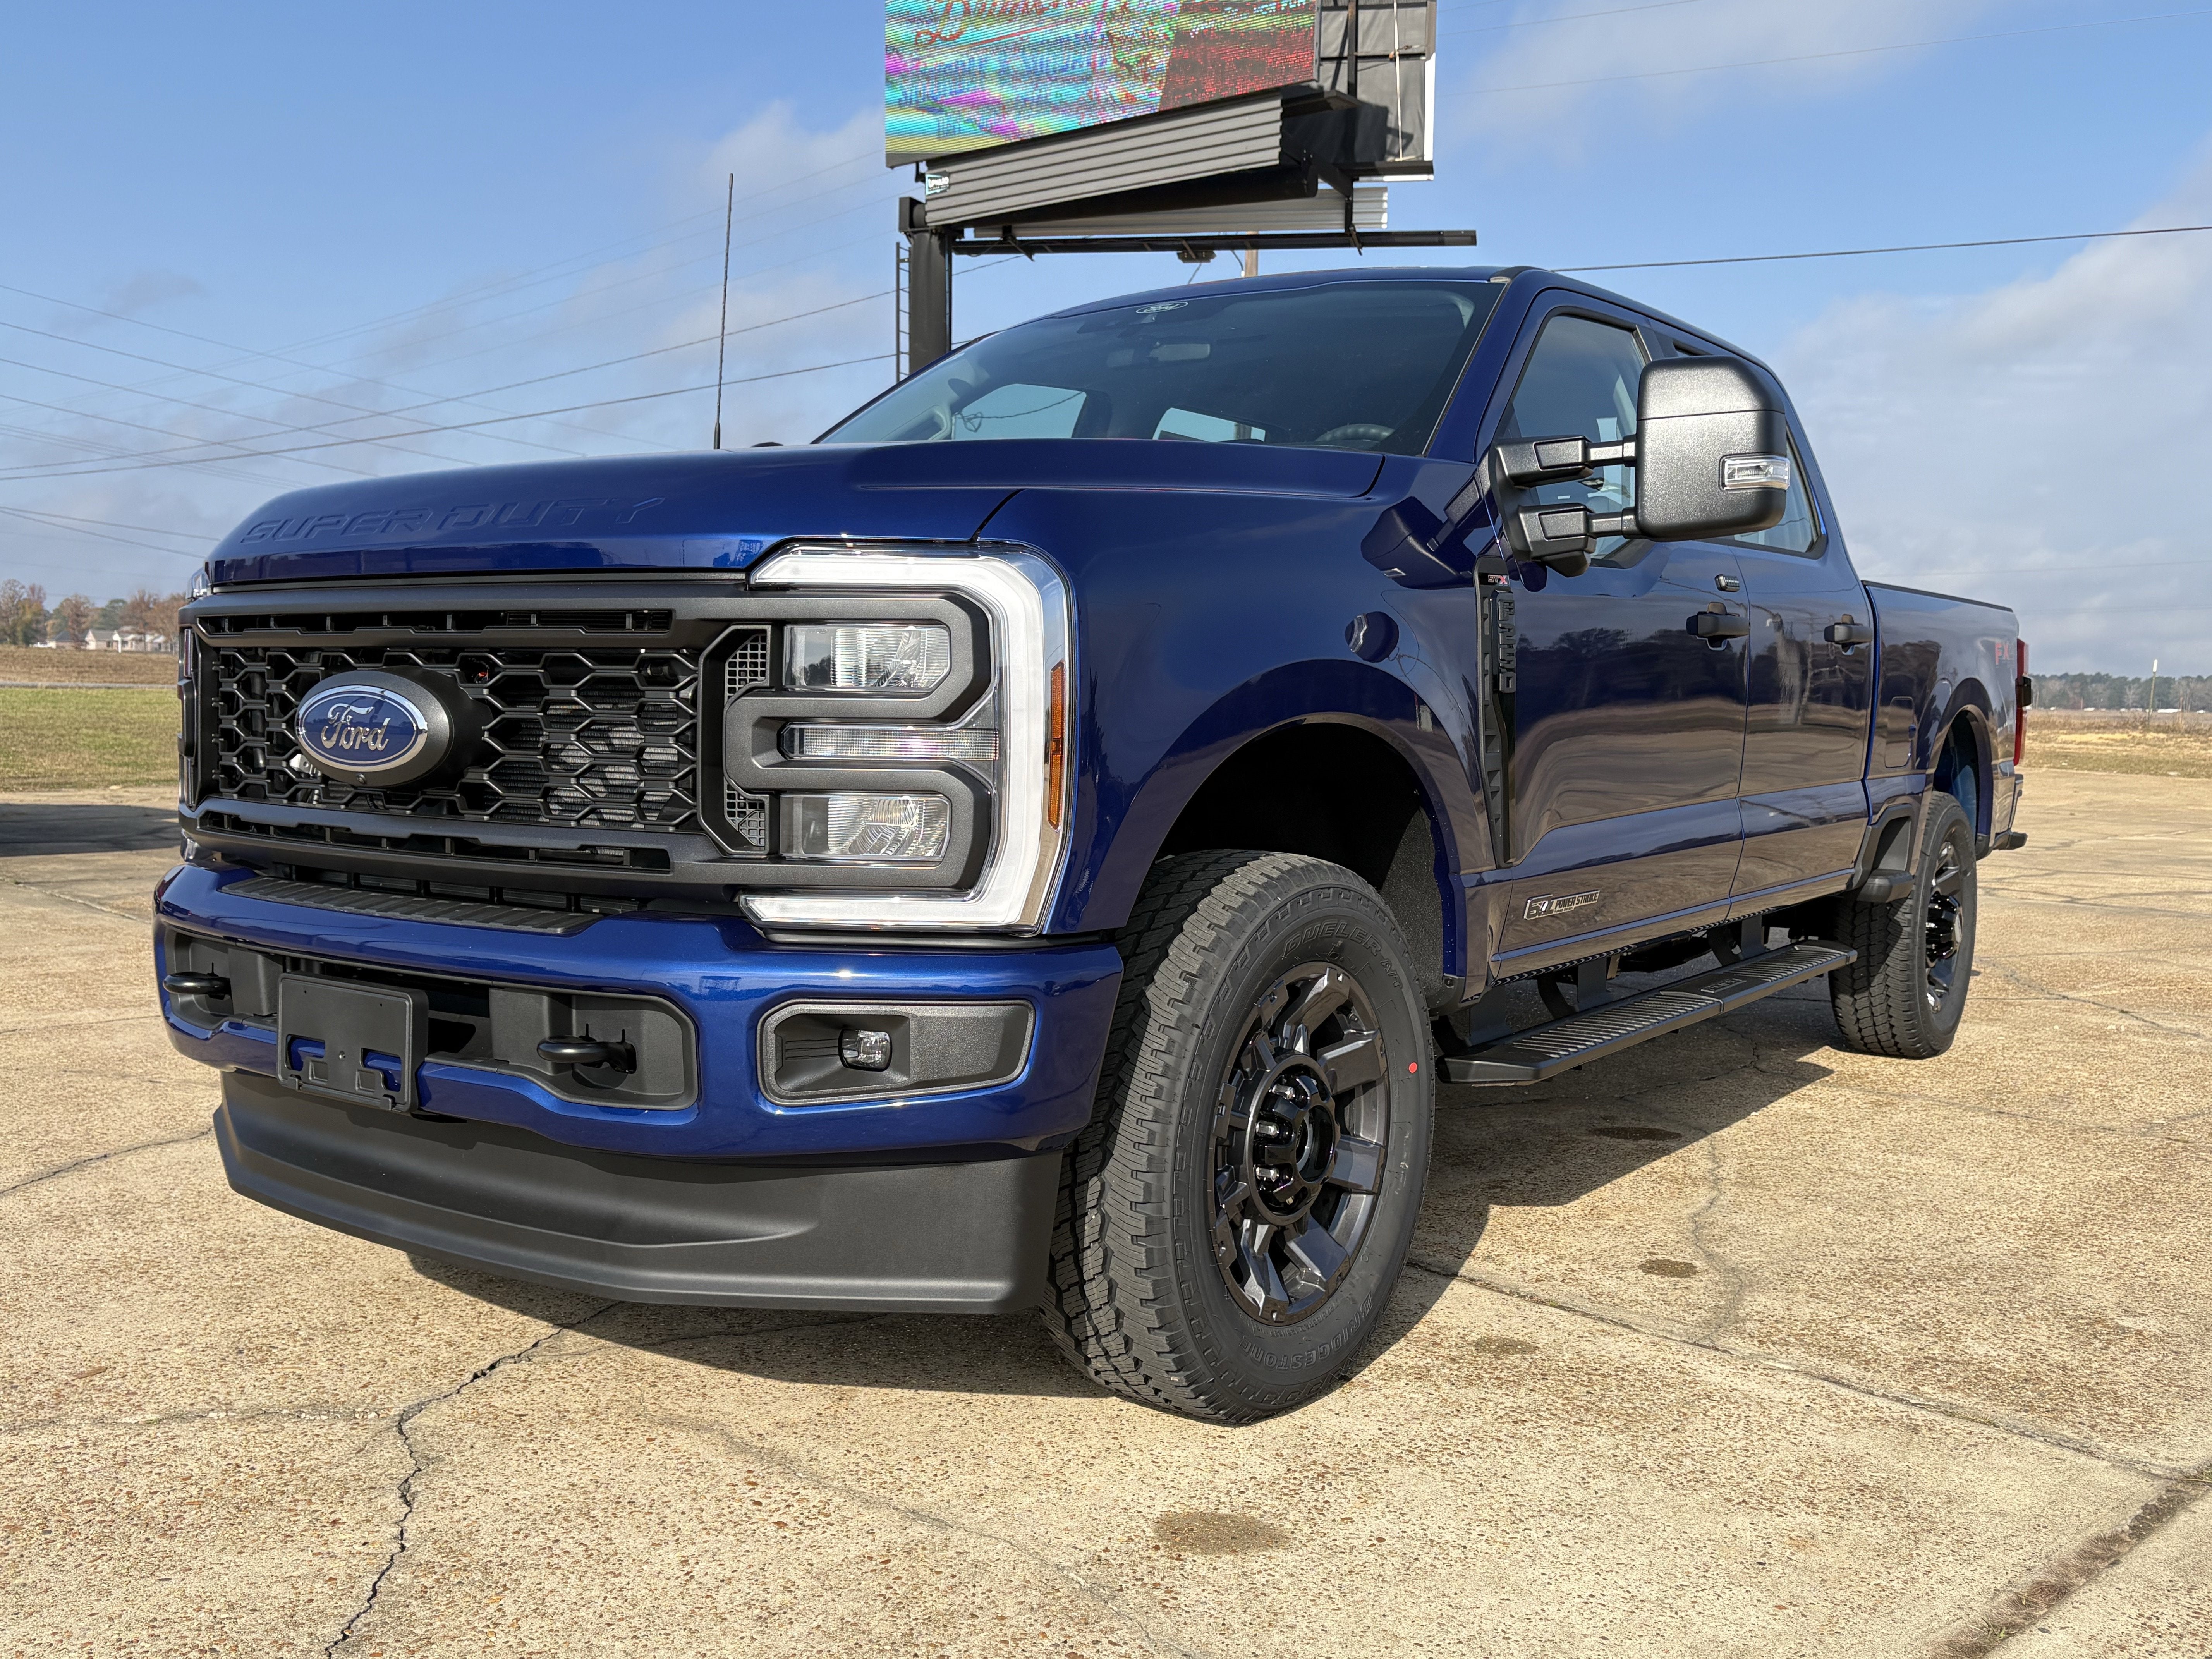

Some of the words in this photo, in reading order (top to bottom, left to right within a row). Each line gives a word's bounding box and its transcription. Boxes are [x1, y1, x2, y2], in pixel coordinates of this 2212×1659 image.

[240, 507, 433, 543] SUPER
[436, 497, 665, 531] DUTY
[1488, 574, 1508, 585] STX
[321, 703, 391, 751] Ford
[1554, 896, 1576, 910] POWER
[1575, 892, 1599, 905] STROKE
[1281, 919, 1381, 960] DUELER
[1380, 958, 1403, 989] A/T
[1220, 1291, 1373, 1371] BRIDGESTONE
